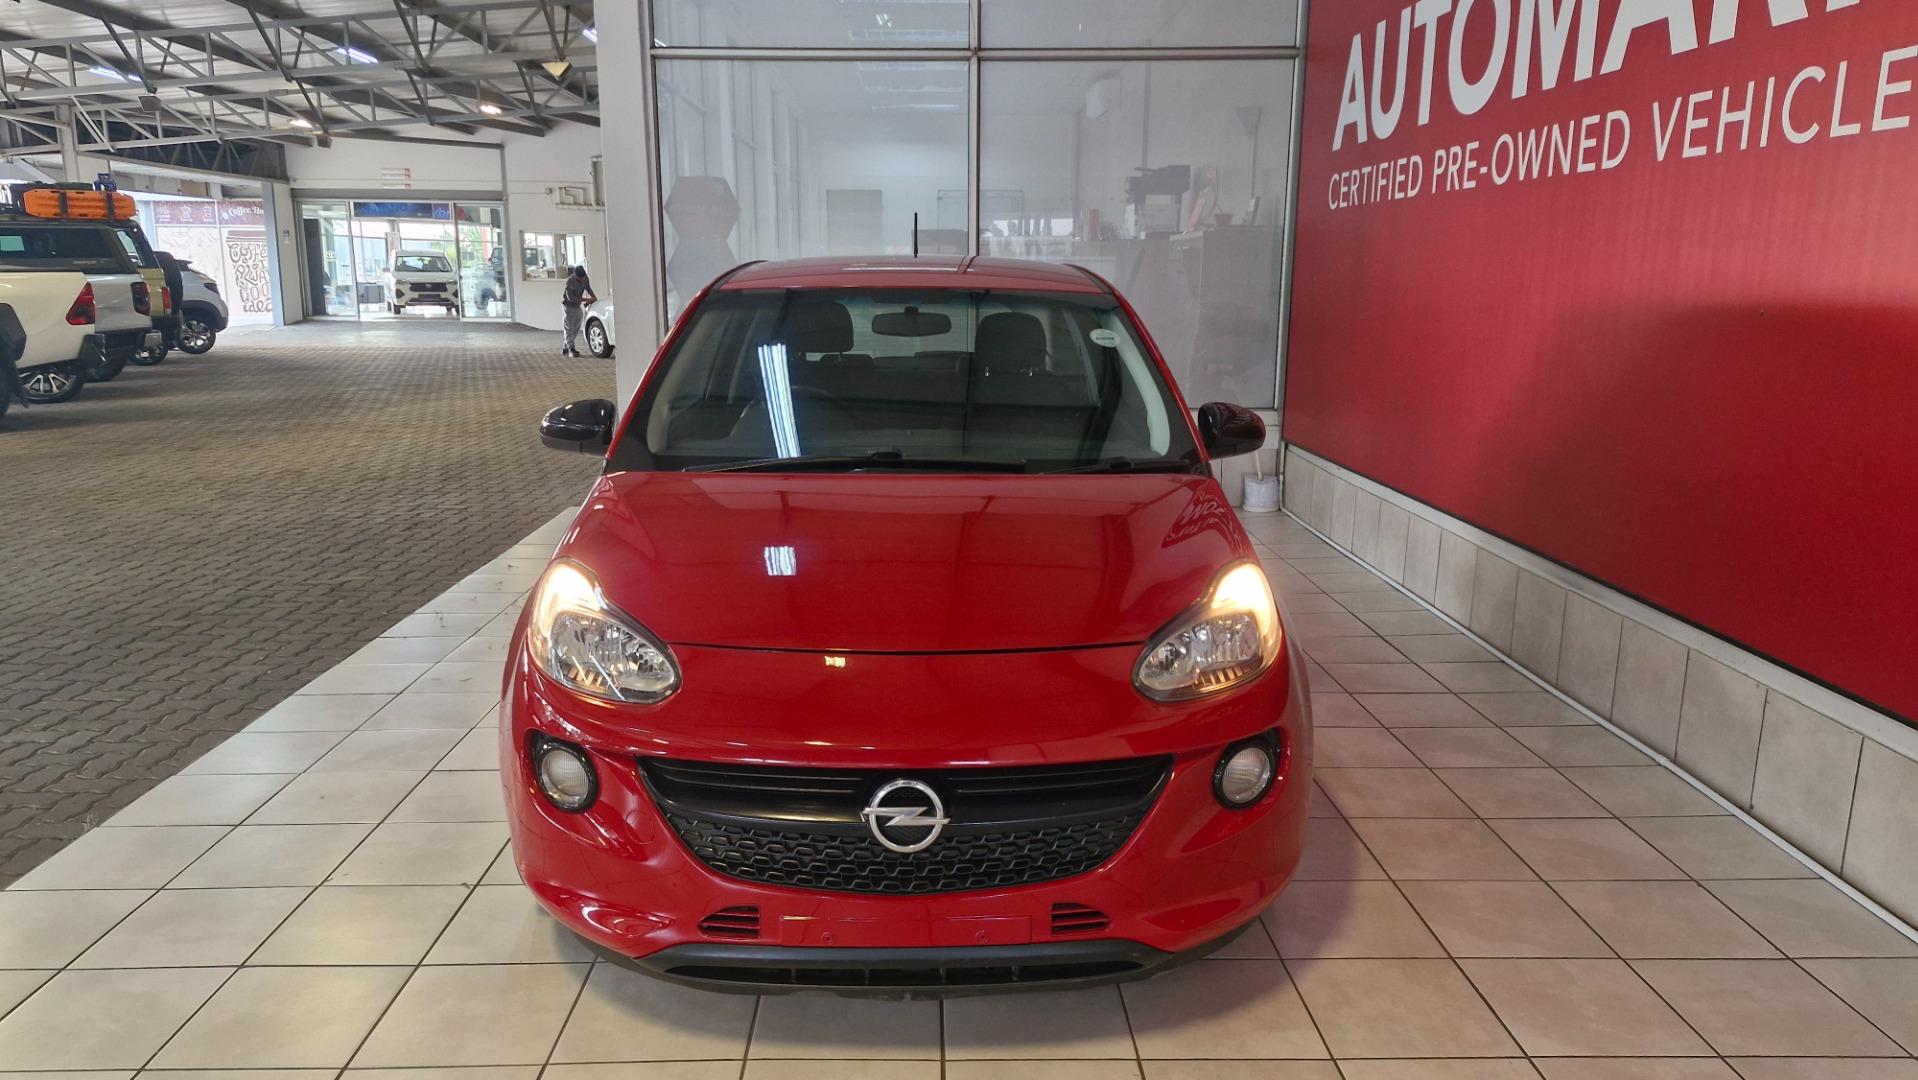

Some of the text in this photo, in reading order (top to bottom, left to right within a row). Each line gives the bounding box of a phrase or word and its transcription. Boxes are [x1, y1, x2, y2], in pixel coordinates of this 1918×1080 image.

[1332, 0, 1862, 151] AUTOM
[1328, 45, 1918, 210] CERTIFIED PRE-OWNED VEHICLE
[228, 206, 252, 217] Coffee
[228, 243, 268, 263] Coffe
